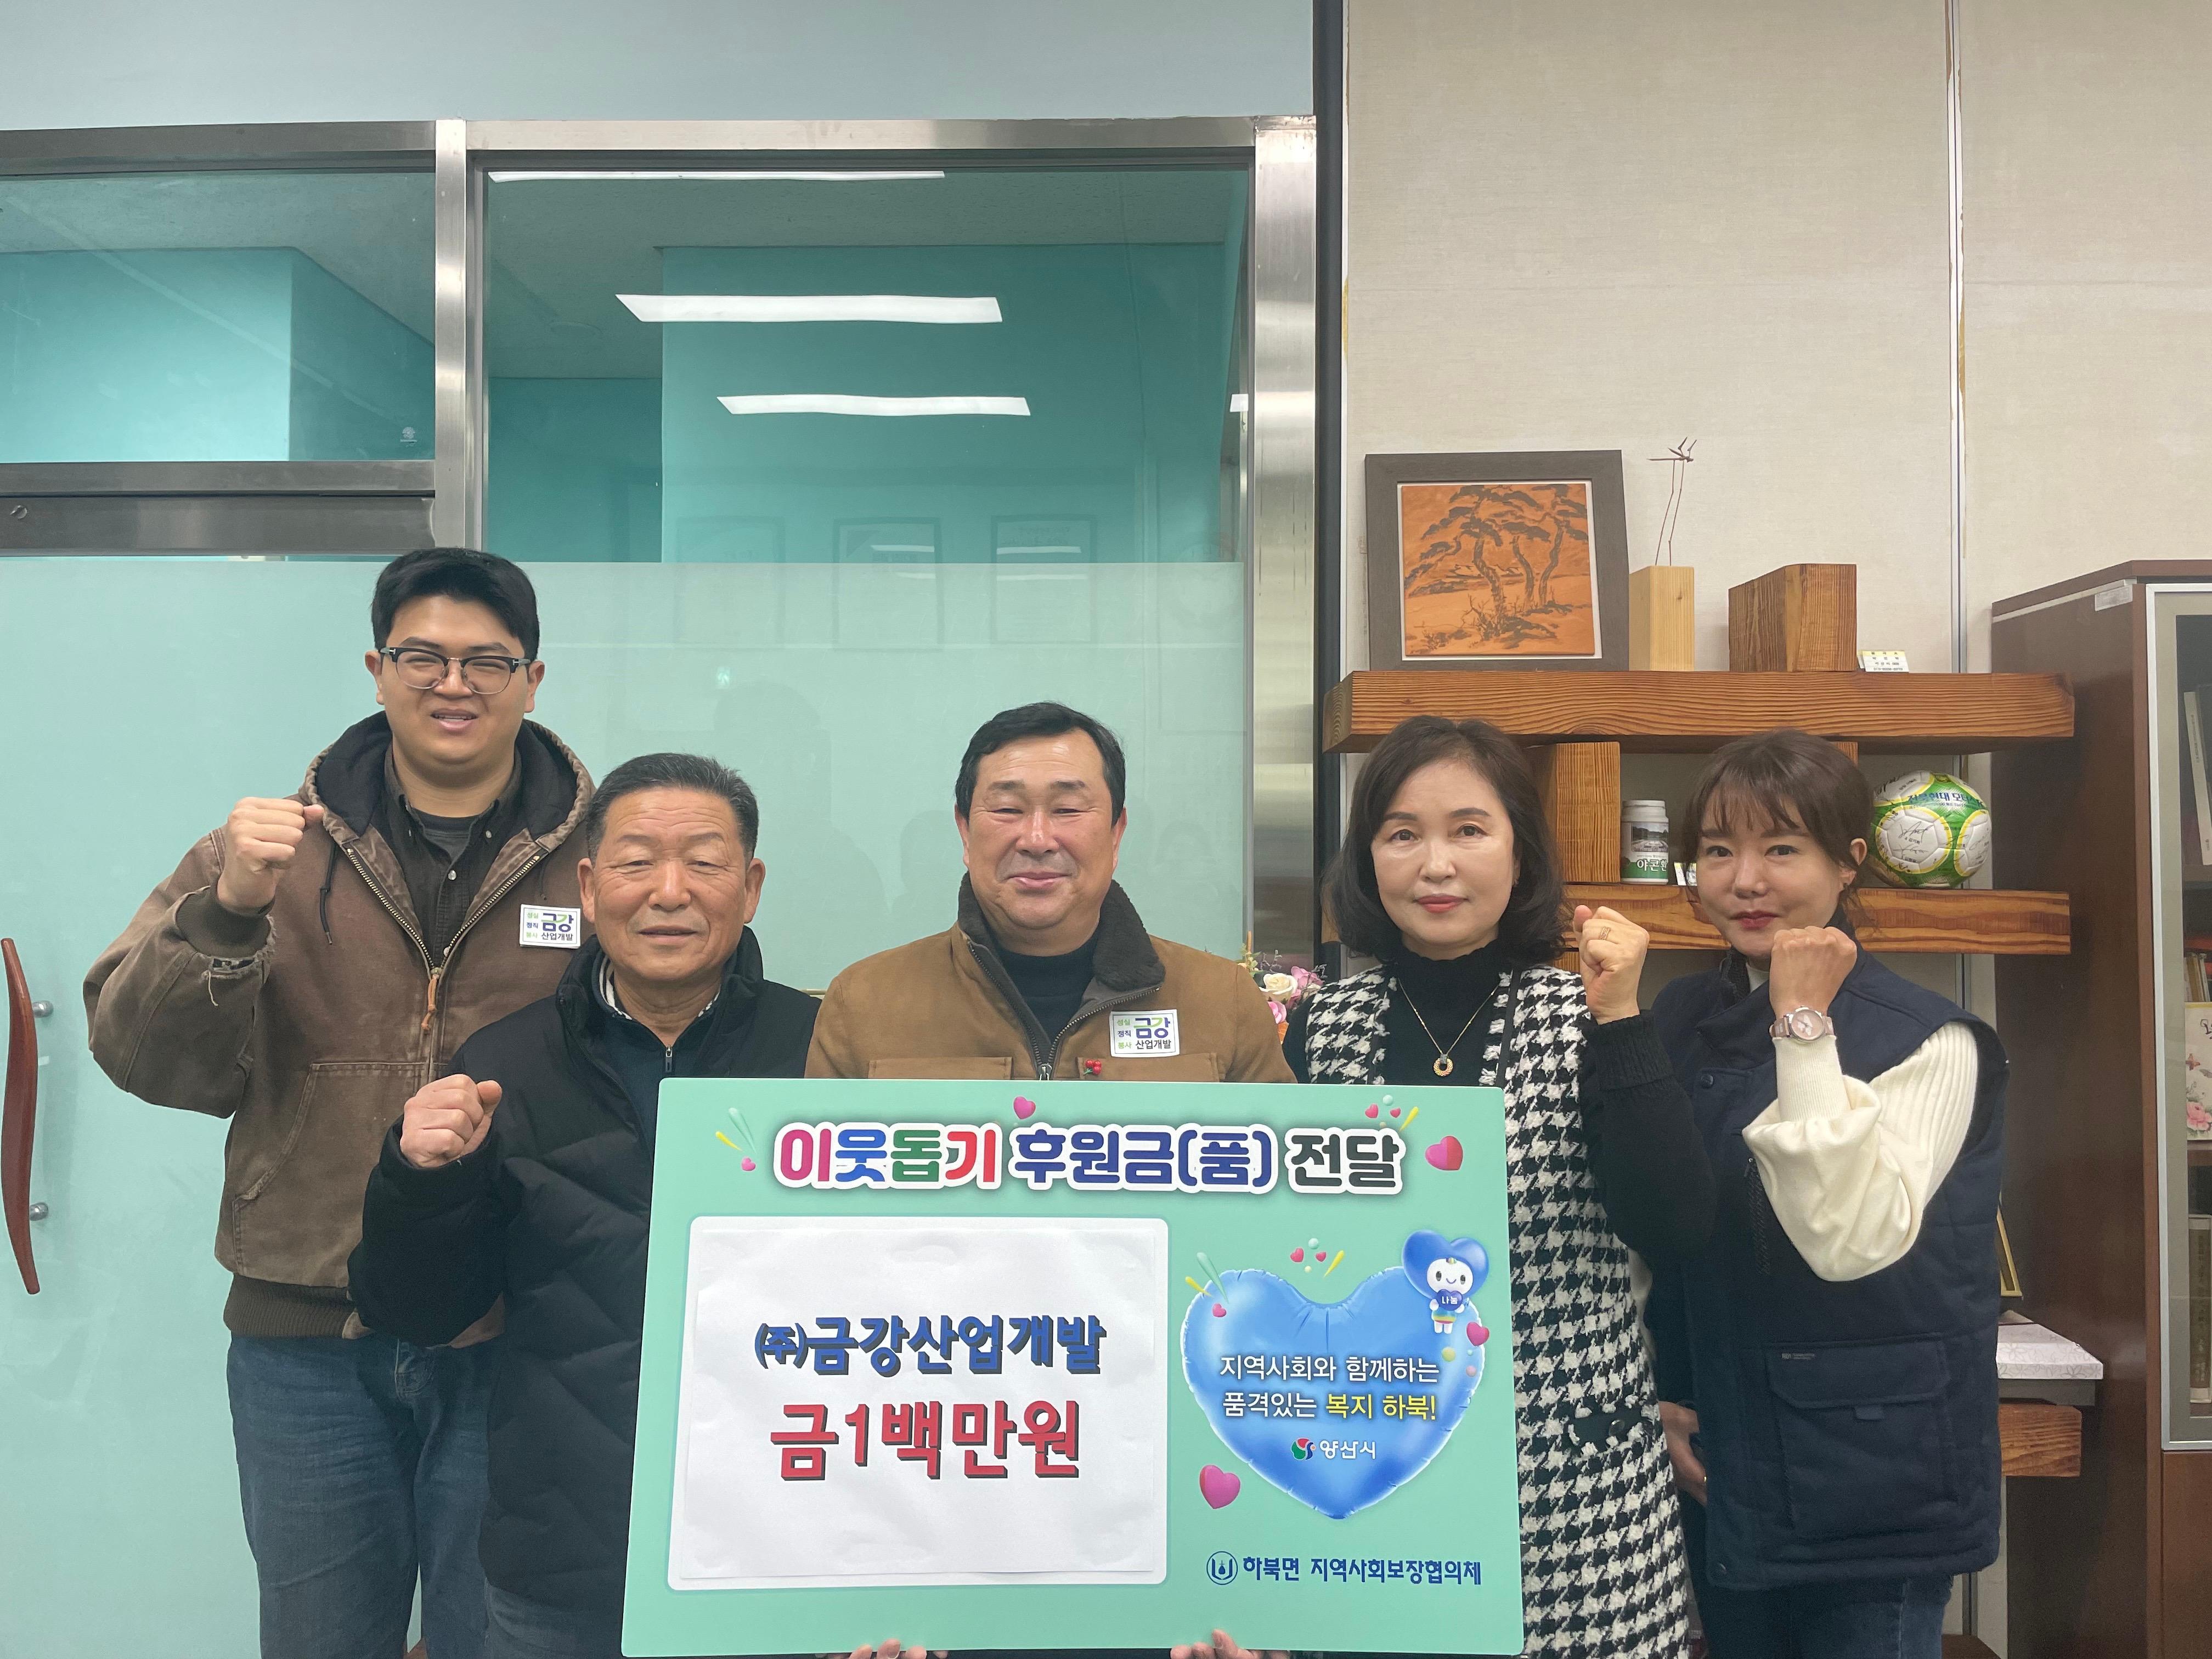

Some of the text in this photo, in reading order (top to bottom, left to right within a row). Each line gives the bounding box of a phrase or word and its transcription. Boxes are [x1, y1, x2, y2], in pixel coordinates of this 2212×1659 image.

[1637, 859, 1668, 872] 야콘환
[541, 913, 574, 933] 금강
[541, 932, 573, 941] 산업개발
[1133, 1017, 1171, 1039] 금강
[1135, 1040, 1171, 1049] 산업개발
[779, 1128, 1400, 1189] 이웃돕기 후원금(품) 전달
[1441, 1295, 1458, 1305] 나눔
[754, 1315, 1107, 1378] (주)금강산업개발
[1220, 1355, 1440, 1383] 지역사회와 함께하는
[1223, 1392, 1436, 1421] 품격있는 복지 하북!
[770, 1400, 1079, 1480] 금1백만원
[1319, 1440, 1376, 1459] 양산시
[1243, 1556, 1482, 1585] 하북면 지역사회보장협의체
